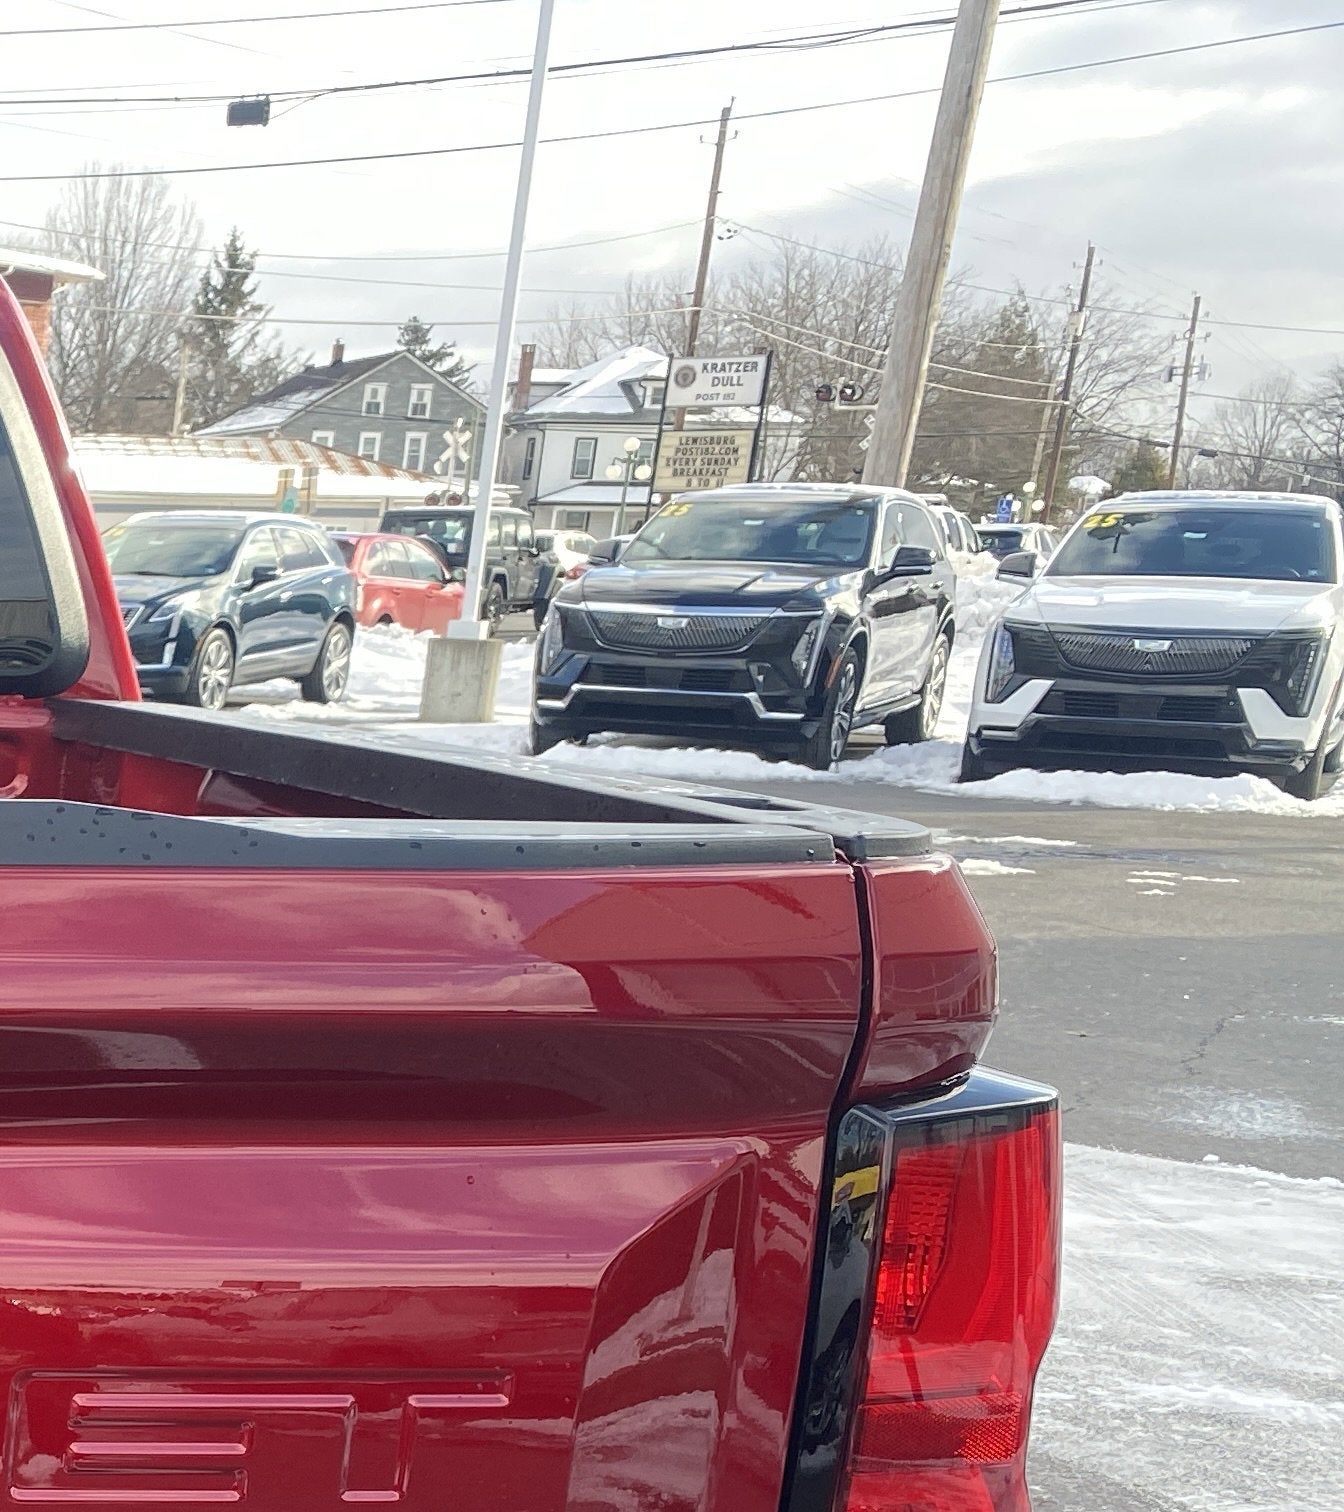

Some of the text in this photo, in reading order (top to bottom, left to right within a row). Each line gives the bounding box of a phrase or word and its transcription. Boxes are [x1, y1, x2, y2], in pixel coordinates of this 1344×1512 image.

[701, 361, 759, 374] KRATZER
[711, 376, 744, 388] DULL
[695, 392, 721, 401] POST
[679, 435, 736, 446] LEWISBURG
[675, 446, 740, 457] POST182.COM
[665, 456, 740, 467] EVERY SUNDAY
[672, 467, 729, 477] BREAKFAST
[697, 477, 711, 488] TO
[1082, 513, 1124, 528] 25
